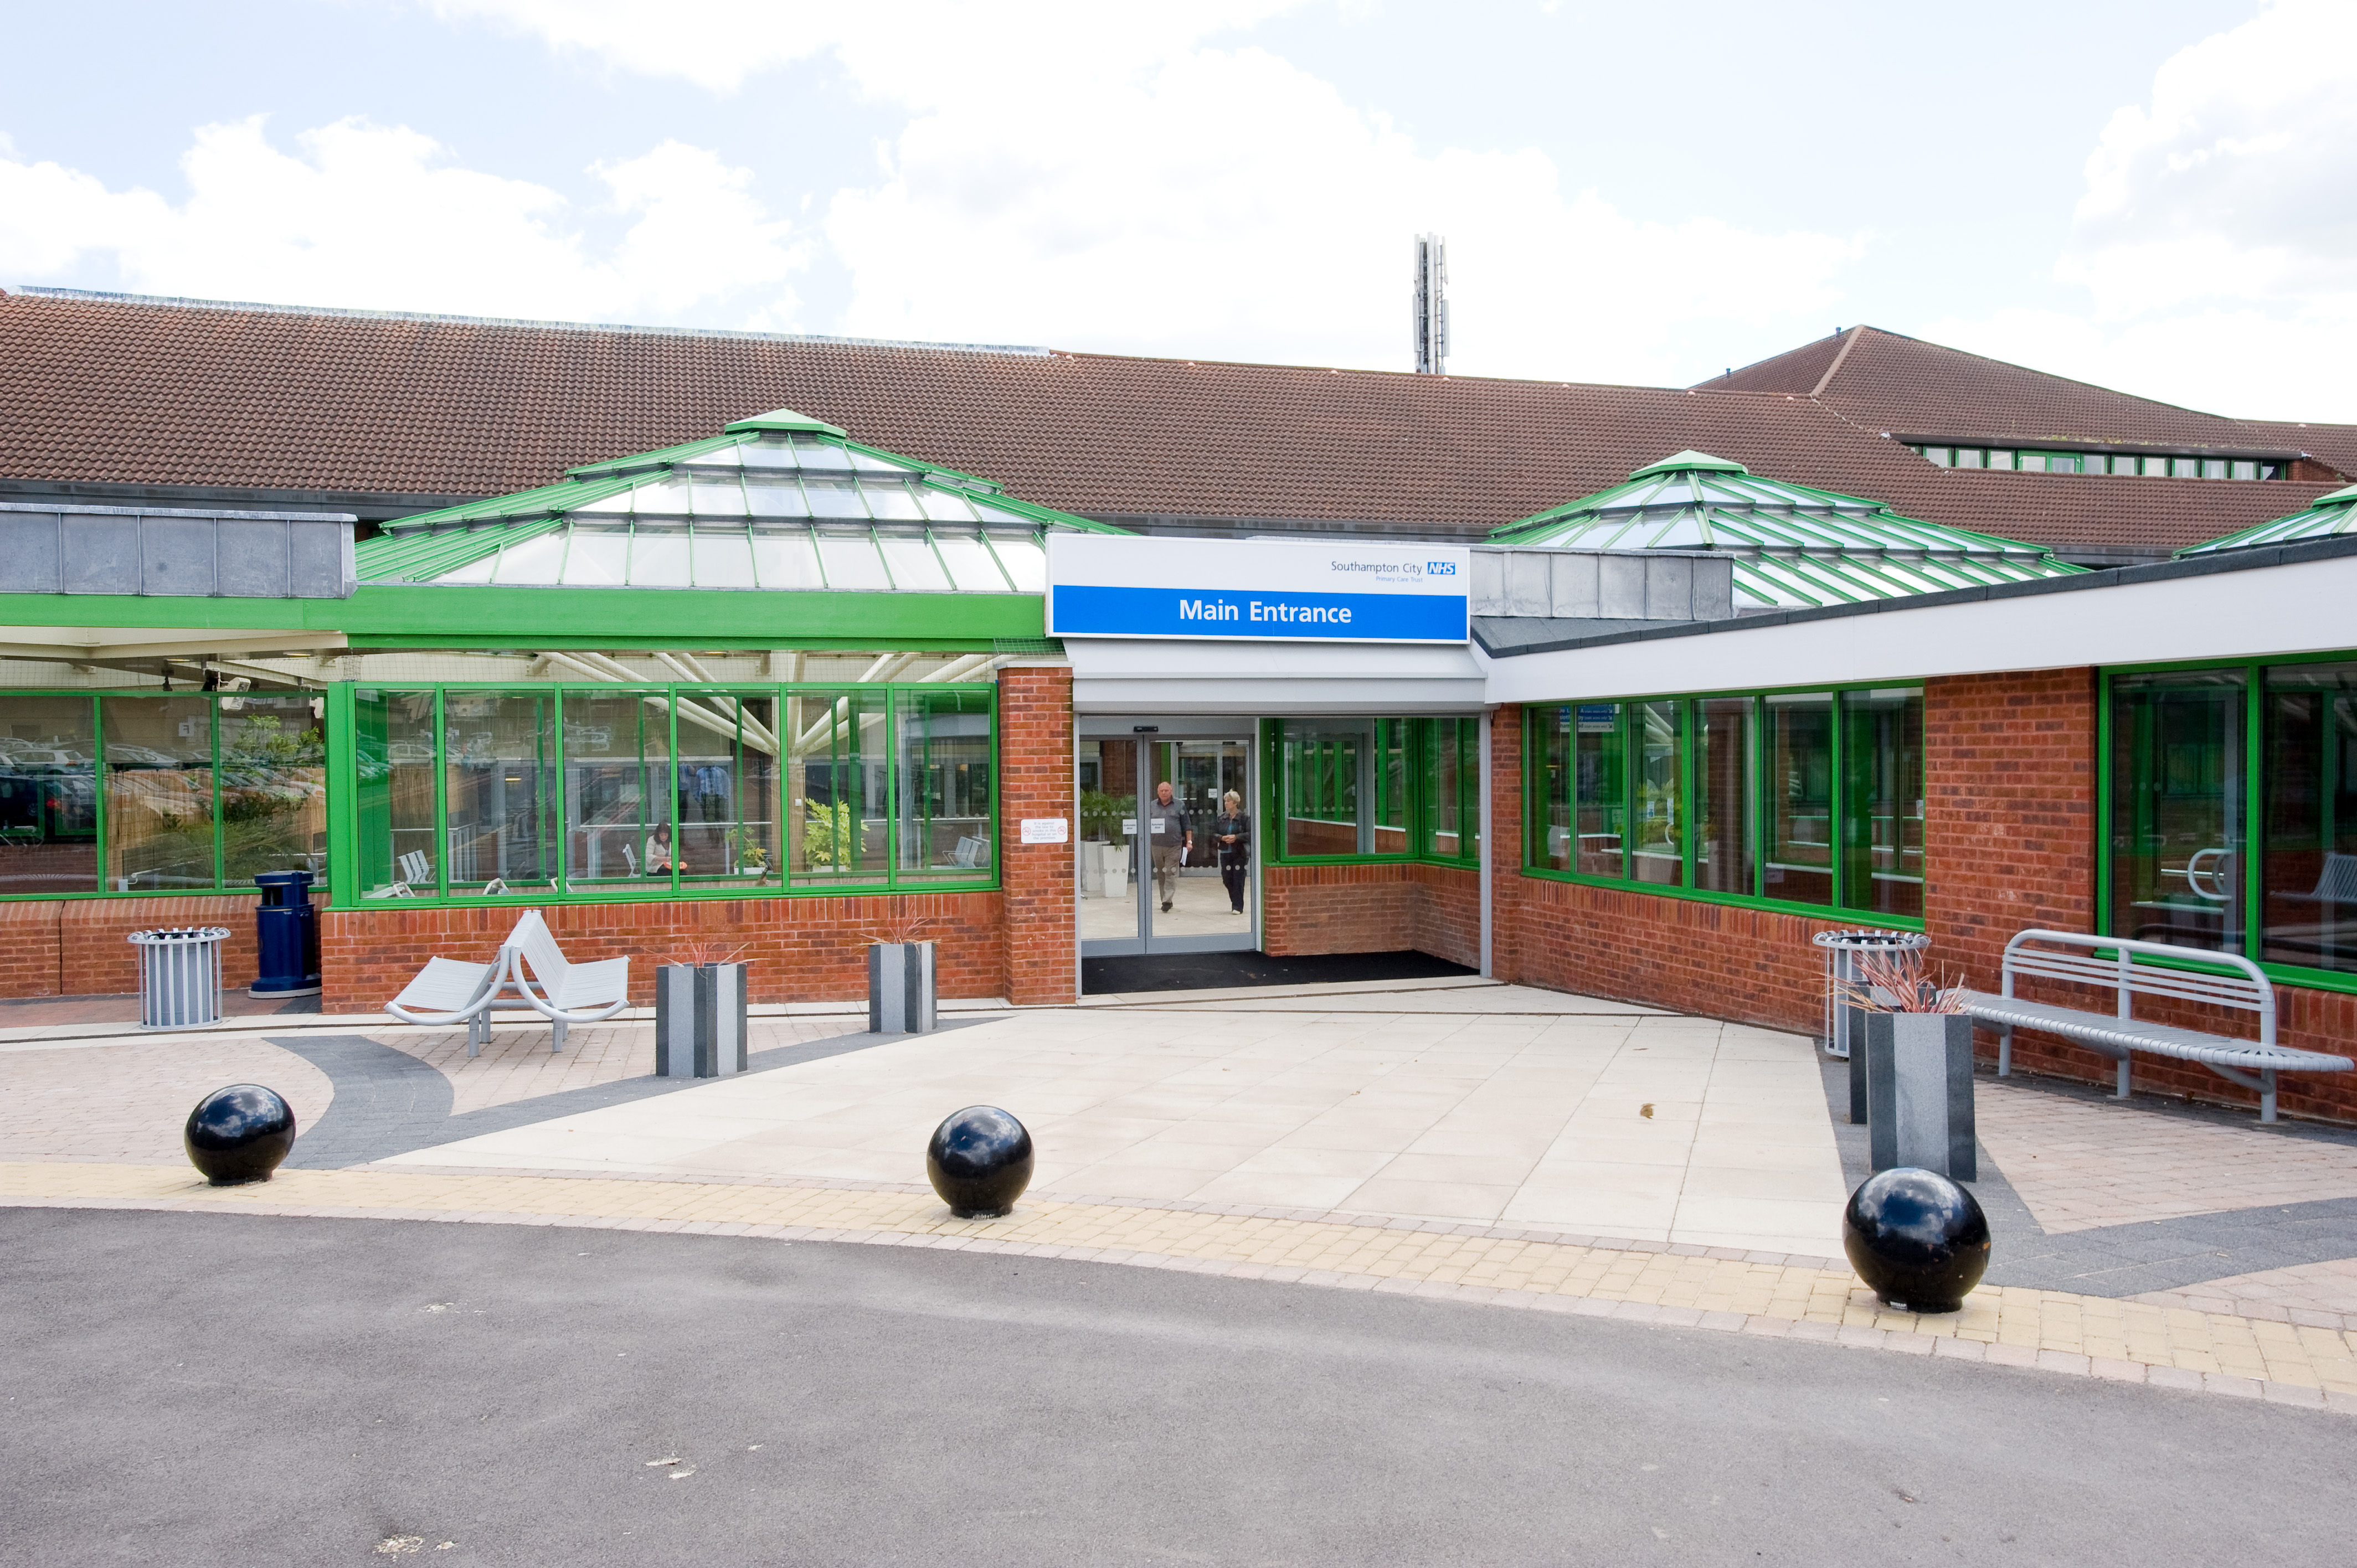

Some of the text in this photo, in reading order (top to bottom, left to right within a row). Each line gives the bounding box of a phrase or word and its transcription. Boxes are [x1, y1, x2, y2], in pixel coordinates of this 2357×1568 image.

[1331, 561, 1422, 575] Southampton City
[1428, 563, 1454, 574] NHS
[1180, 599, 1352, 623] Main Entrance
